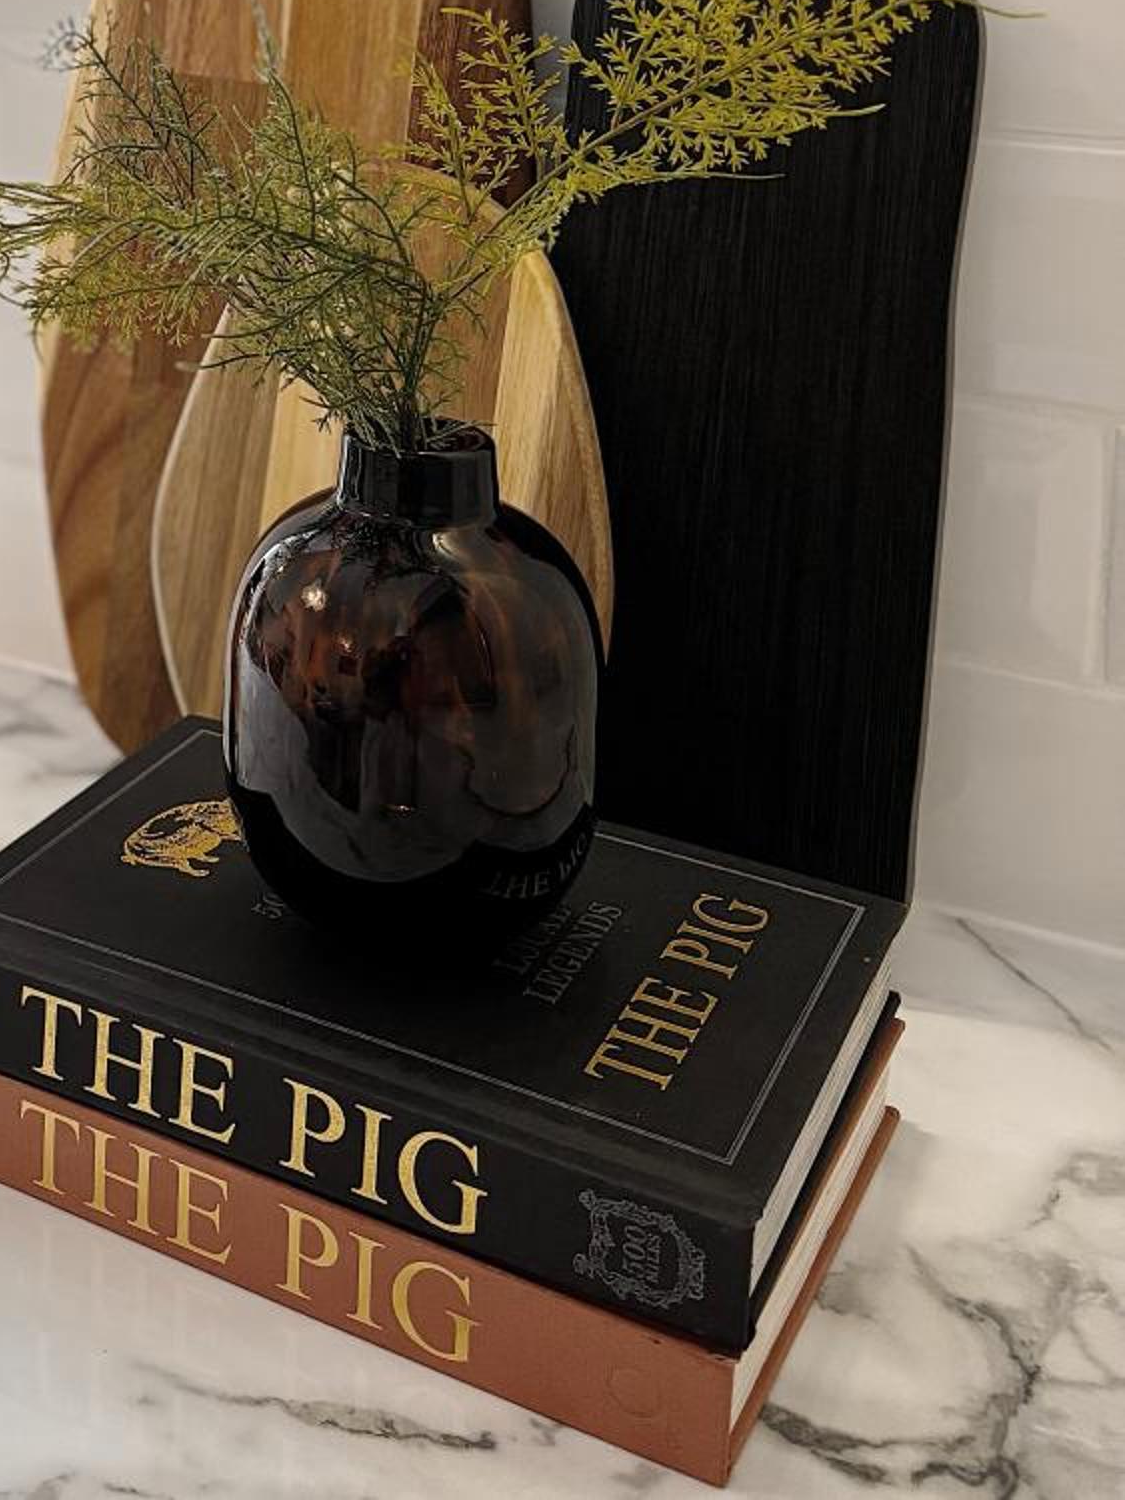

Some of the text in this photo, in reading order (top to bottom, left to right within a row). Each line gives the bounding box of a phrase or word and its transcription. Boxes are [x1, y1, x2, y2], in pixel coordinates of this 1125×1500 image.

[525, 900, 623, 1005] LEGENDS
[583, 891, 773, 1091] THE PIG
[20, 985, 488, 1235] THE PIG
[20, 1099, 482, 1363] THE PIG
